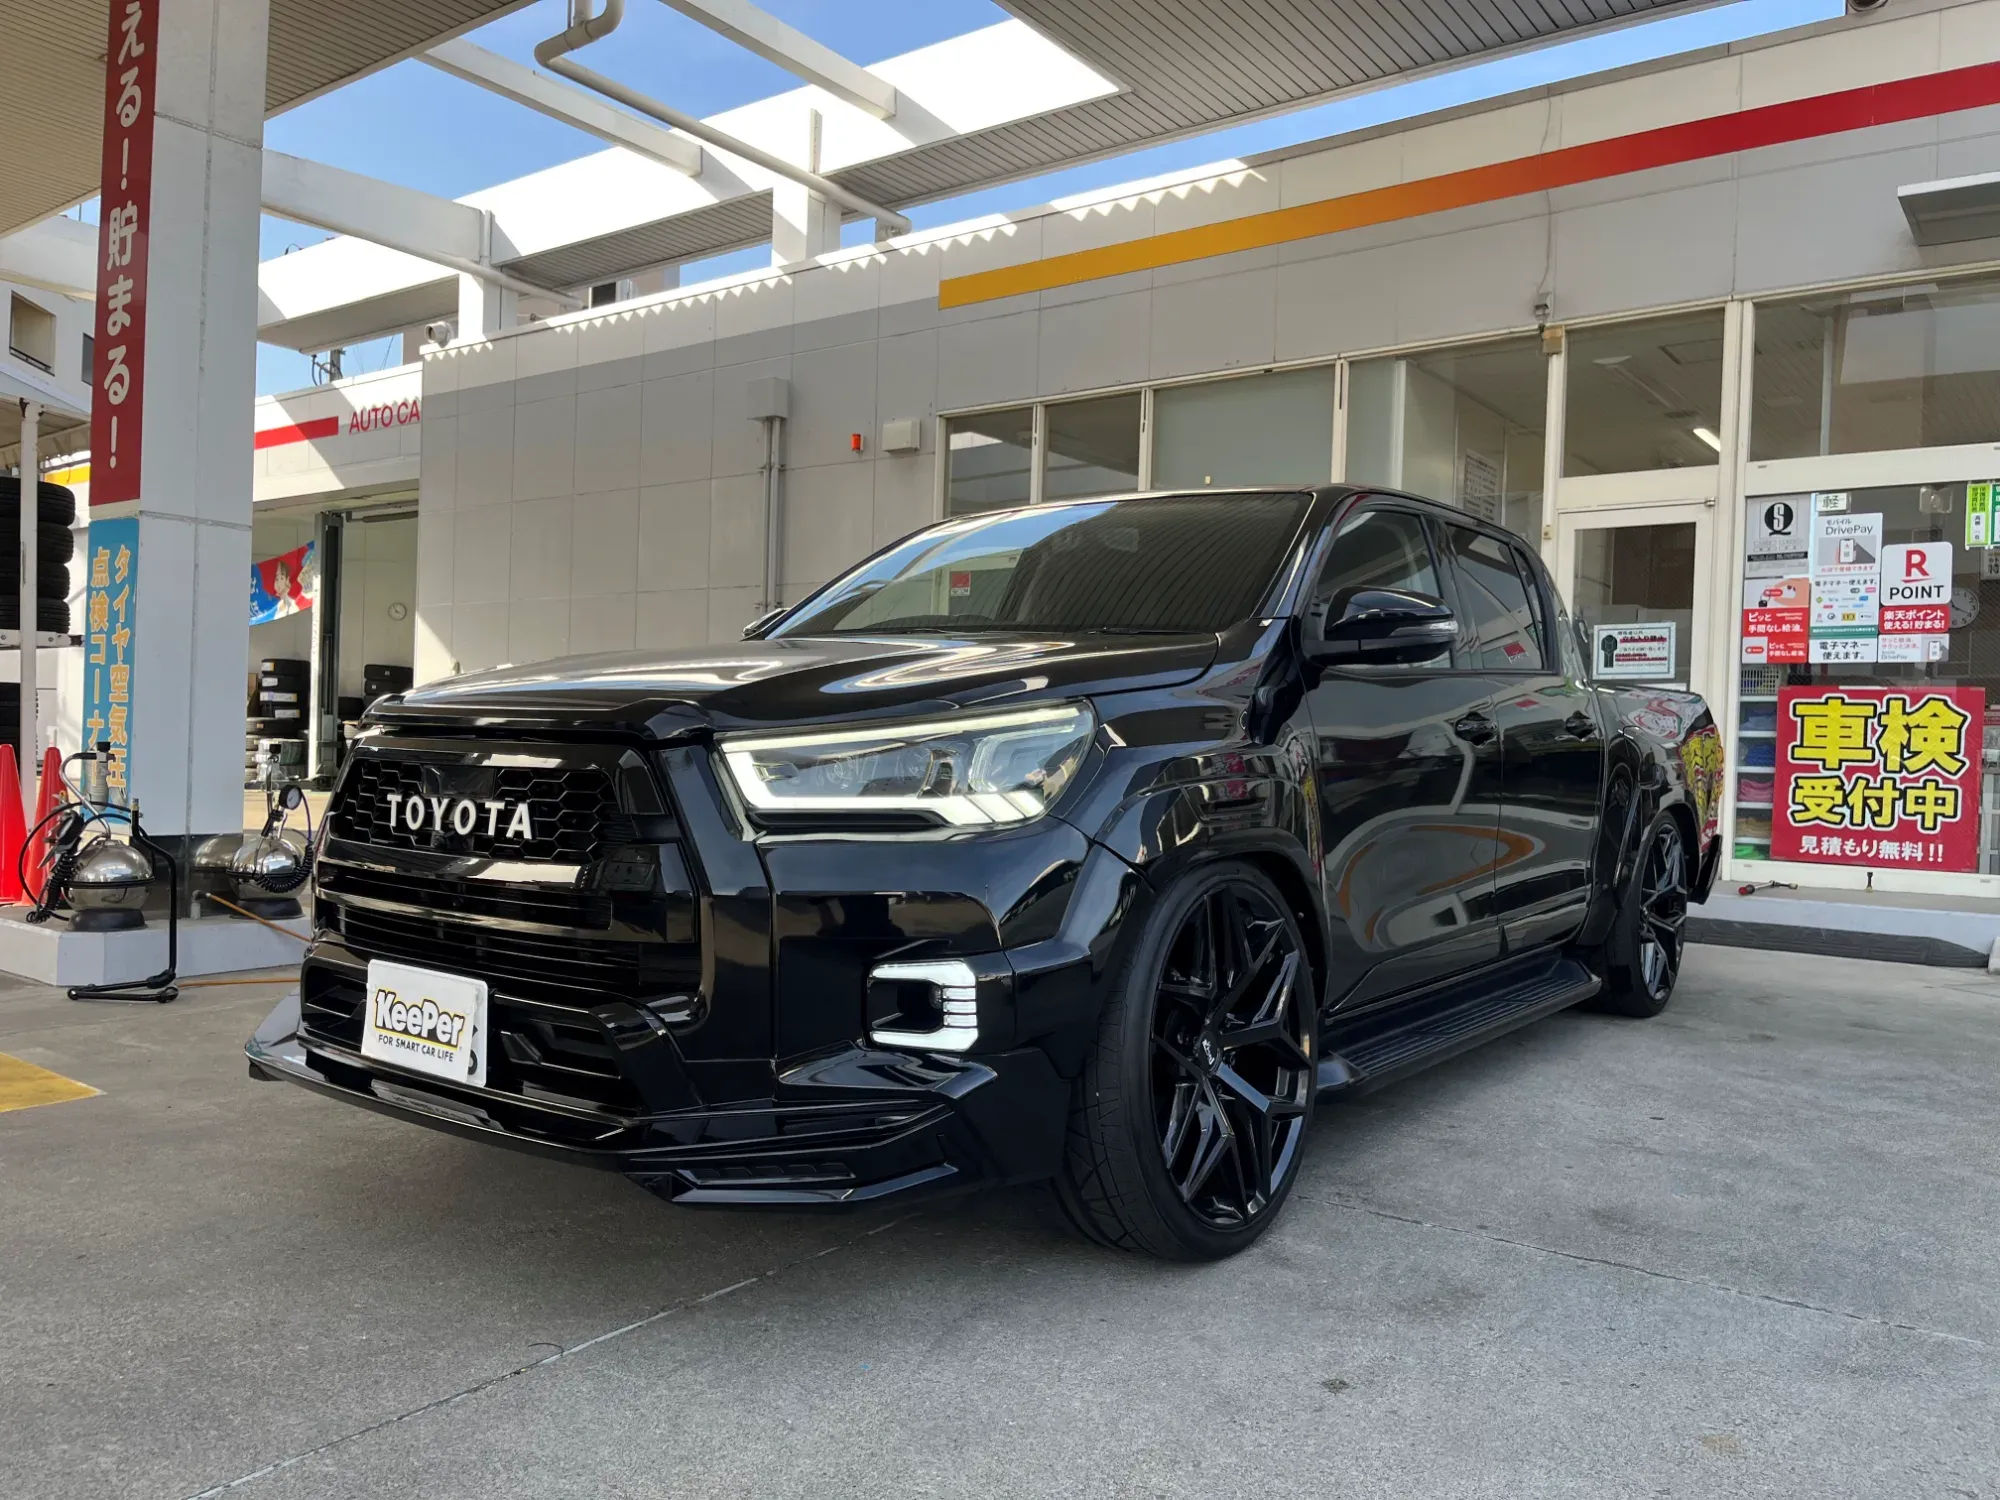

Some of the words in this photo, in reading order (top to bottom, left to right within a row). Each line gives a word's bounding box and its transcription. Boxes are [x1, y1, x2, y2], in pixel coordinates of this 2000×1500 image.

[349, 405, 393, 435] AUTO
[1825, 525, 1874, 536] DrivePay
[1905, 549, 1930, 578] R
[1889, 585, 1944, 600] POINT
[1748, 612, 1772, 622] ピッと
[1884, 609, 1945, 620] 楽天ポイント
[1819, 641, 1870, 651] 電子マネー
[1823, 651, 1865, 660] 使えます。
[106, 544, 131, 788] タイヤ空気圧
[1789, 695, 1970, 778] 車検
[386, 793, 532, 840] TOYOTA
[1788, 775, 1960, 833] 受付中
[1799, 835, 1944, 863] 見積もり無料!!
[375, 988, 466, 1048] KeePer
[378, 1034, 393, 1046] FOR
[395, 1038, 420, 1053] SMART
[421, 1045, 436, 1057] CAR
[437, 1050, 454, 1062] LIFE
